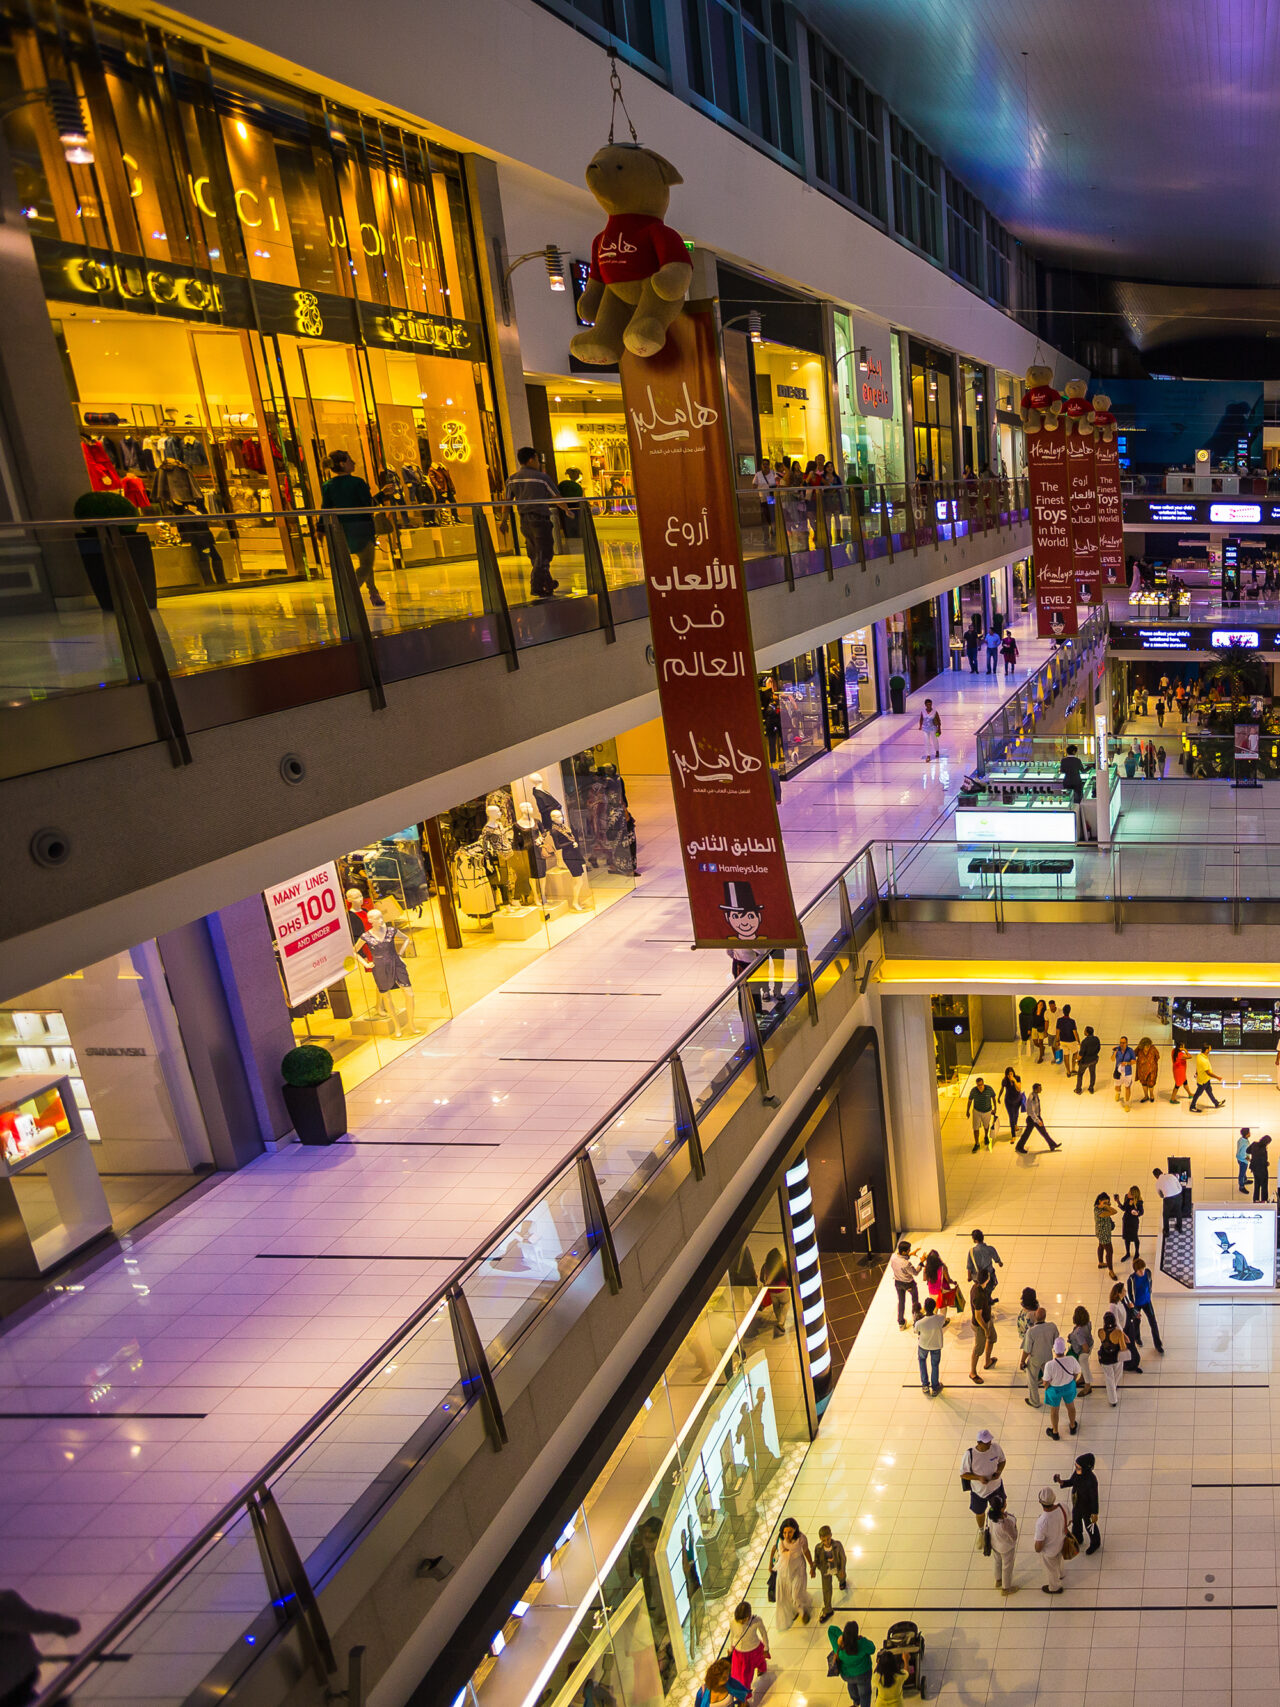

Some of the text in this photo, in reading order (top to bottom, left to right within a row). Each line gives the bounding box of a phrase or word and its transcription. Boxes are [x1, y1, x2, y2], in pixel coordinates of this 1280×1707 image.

[62, 257, 225, 313] GUCCI
[576, 423, 627, 433] DIESE
[1030, 440, 1066, 460] Hamleys
[1040, 482, 1059, 491] The
[1036, 495, 1065, 505] Finest
[1097, 494, 1119, 507] Toys
[1035, 506, 1068, 524] Toys
[664, 506, 709, 547] أروع
[1039, 526, 1066, 535] in the
[1037, 537, 1069, 548] World!
[650, 557, 738, 598] الألعاب
[1037, 564, 1073, 583] Hamleys
[1040, 596, 1072, 605] LEVEL 2
[669, 603, 725, 641] في
[663, 651, 746, 682] العالم
[687, 836, 777, 859] الطابق الثاني
[718, 863, 769, 874] HamleysUae
[273, 871, 329, 906] MANY LINES
[278, 887, 336, 938] DHS 100
[297, 926, 331, 949] AND UNDER
